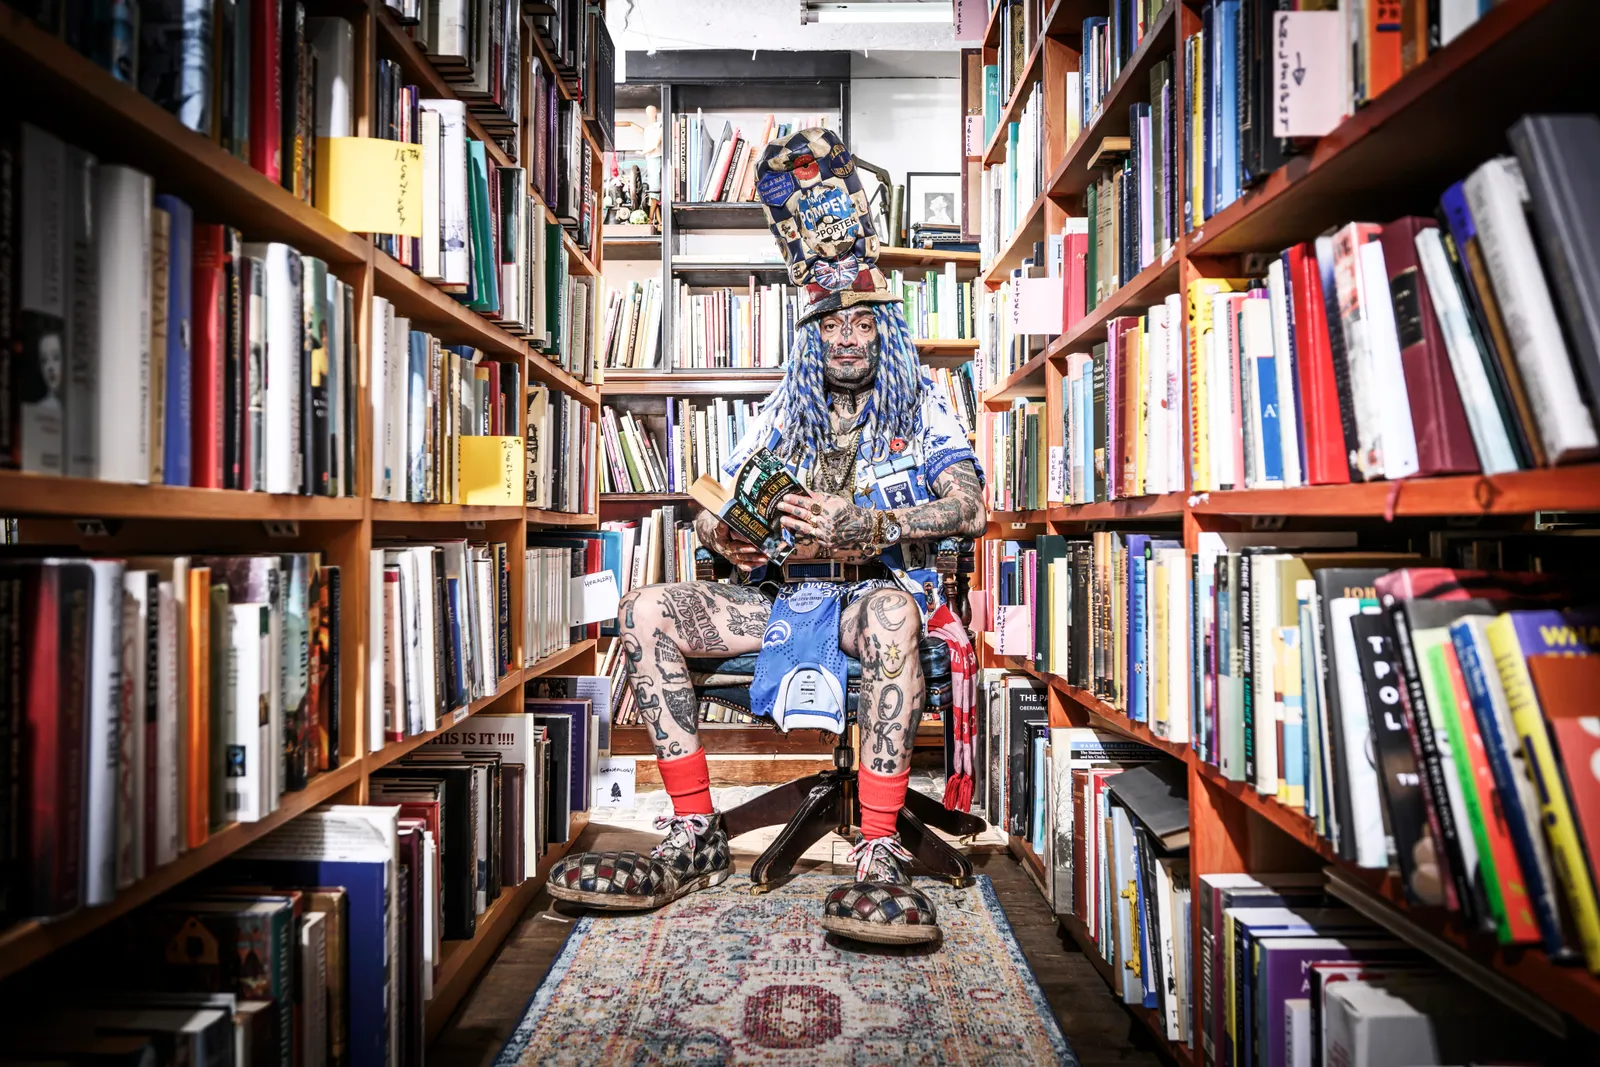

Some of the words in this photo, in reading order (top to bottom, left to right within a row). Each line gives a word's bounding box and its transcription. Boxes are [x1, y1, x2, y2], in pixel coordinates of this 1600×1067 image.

[1278, 14, 1290, 132] PHILOSOPHY
[800, 194, 848, 223] POMPEY
[1013, 280, 1021, 325] LITURGY
[746, 518, 770, 539] CENTURY
[1241, 556, 1250, 587] PICNIC
[1103, 594, 1111, 650] Christians
[1241, 590, 1250, 622] COMMA
[1242, 626, 1251, 673] LIGHTNING
[1020, 694, 1037, 702] THE
[461, 732, 477, 746] IS
[479, 732, 495, 746] IT
[497, 732, 515, 746] !!!!
[1202, 926, 1213, 1013] FEMINISMS
